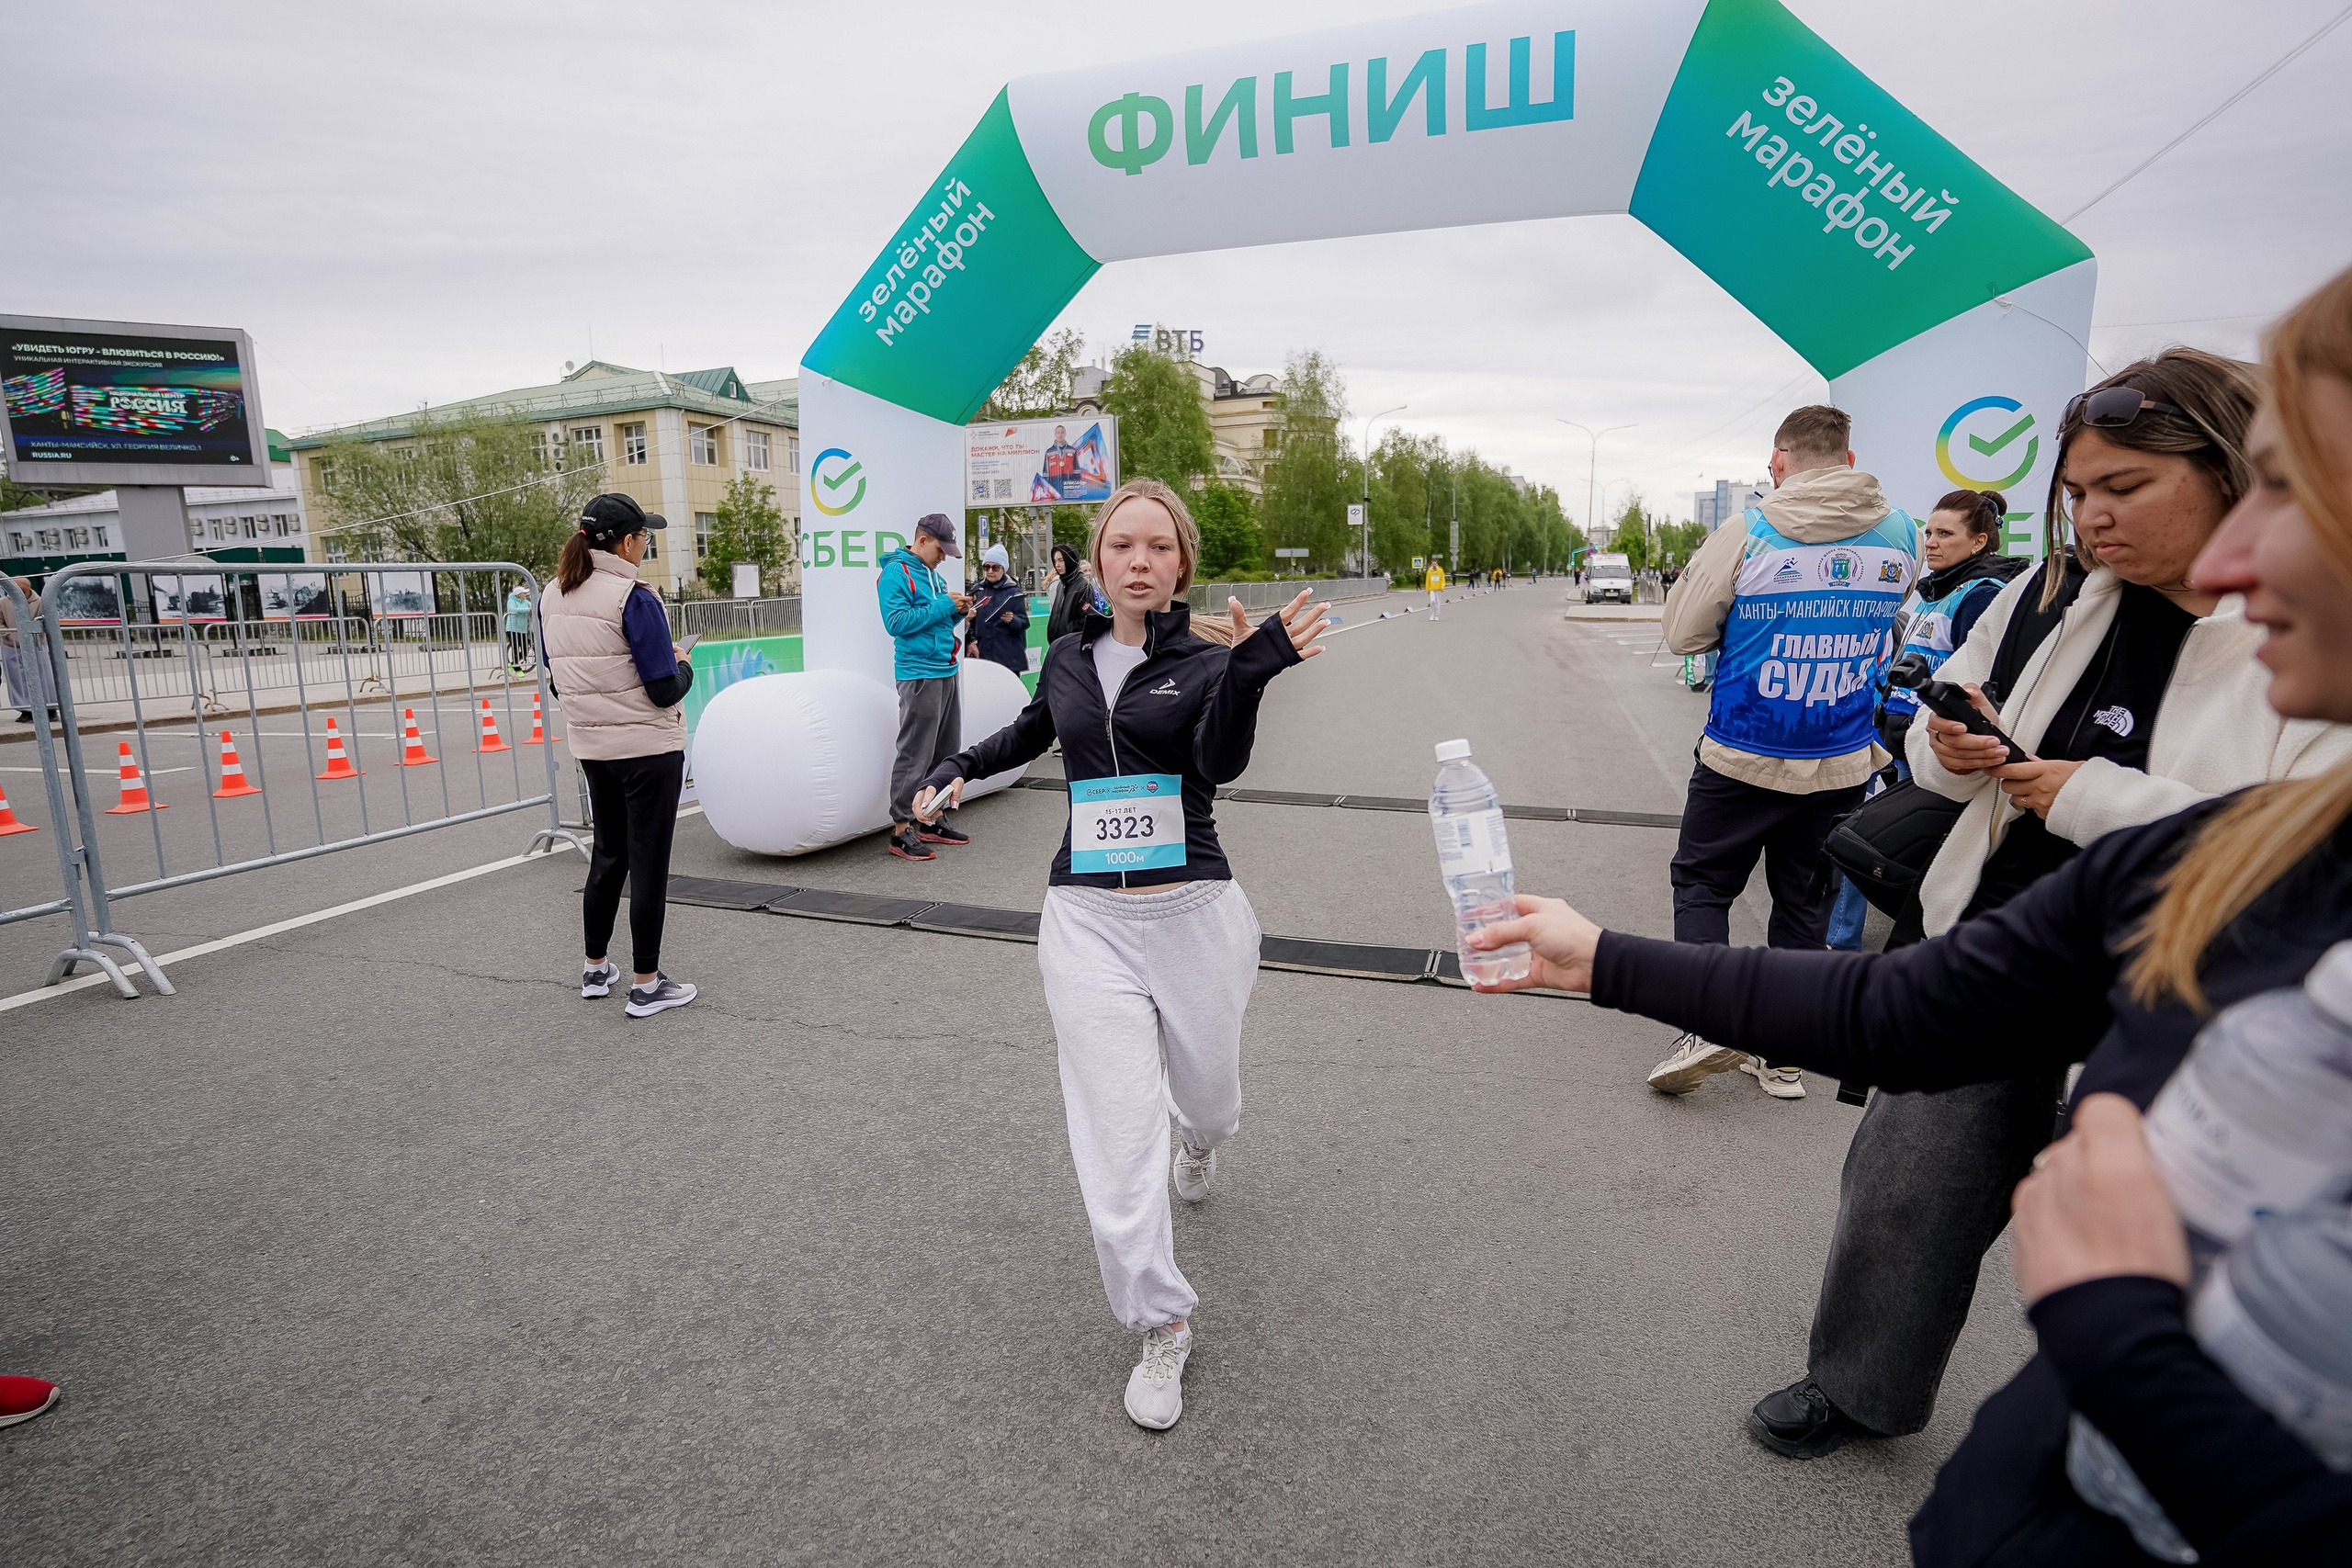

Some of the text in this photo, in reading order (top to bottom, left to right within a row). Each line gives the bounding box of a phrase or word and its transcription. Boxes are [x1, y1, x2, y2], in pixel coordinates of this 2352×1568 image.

[1088, 29, 1576, 175] ФИНИШ
[1762, 76, 1960, 234] зелёный
[1725, 110, 1916, 271] марафон
[859, 177, 971, 323] зелёный
[876, 201, 995, 347] марафон
[66, 346, 95, 355] ЮГРУ
[102, 348, 164, 358] ВЛЮБИТЬСЯ
[165, 351, 173, 359] В
[1156, 330, 1204, 354] ВТБ
[14, 355, 164, 368] УНИКАЛЬНАЯ ИНТЕРАКТИВНАЯ ЭКСКУРСИЯ
[31, 451, 73, 459] RUSSIA.RU
[981, 518, 988, 536] P
[801, 530, 908, 569] СБЕР
[1852, 600, 1882, 618] ЮГРА
[1770, 627, 1882, 659] ГЛАВНЫЙ
[1758, 656, 1875, 707] СУДЬЯ
[1096, 815, 1155, 841] 3323
